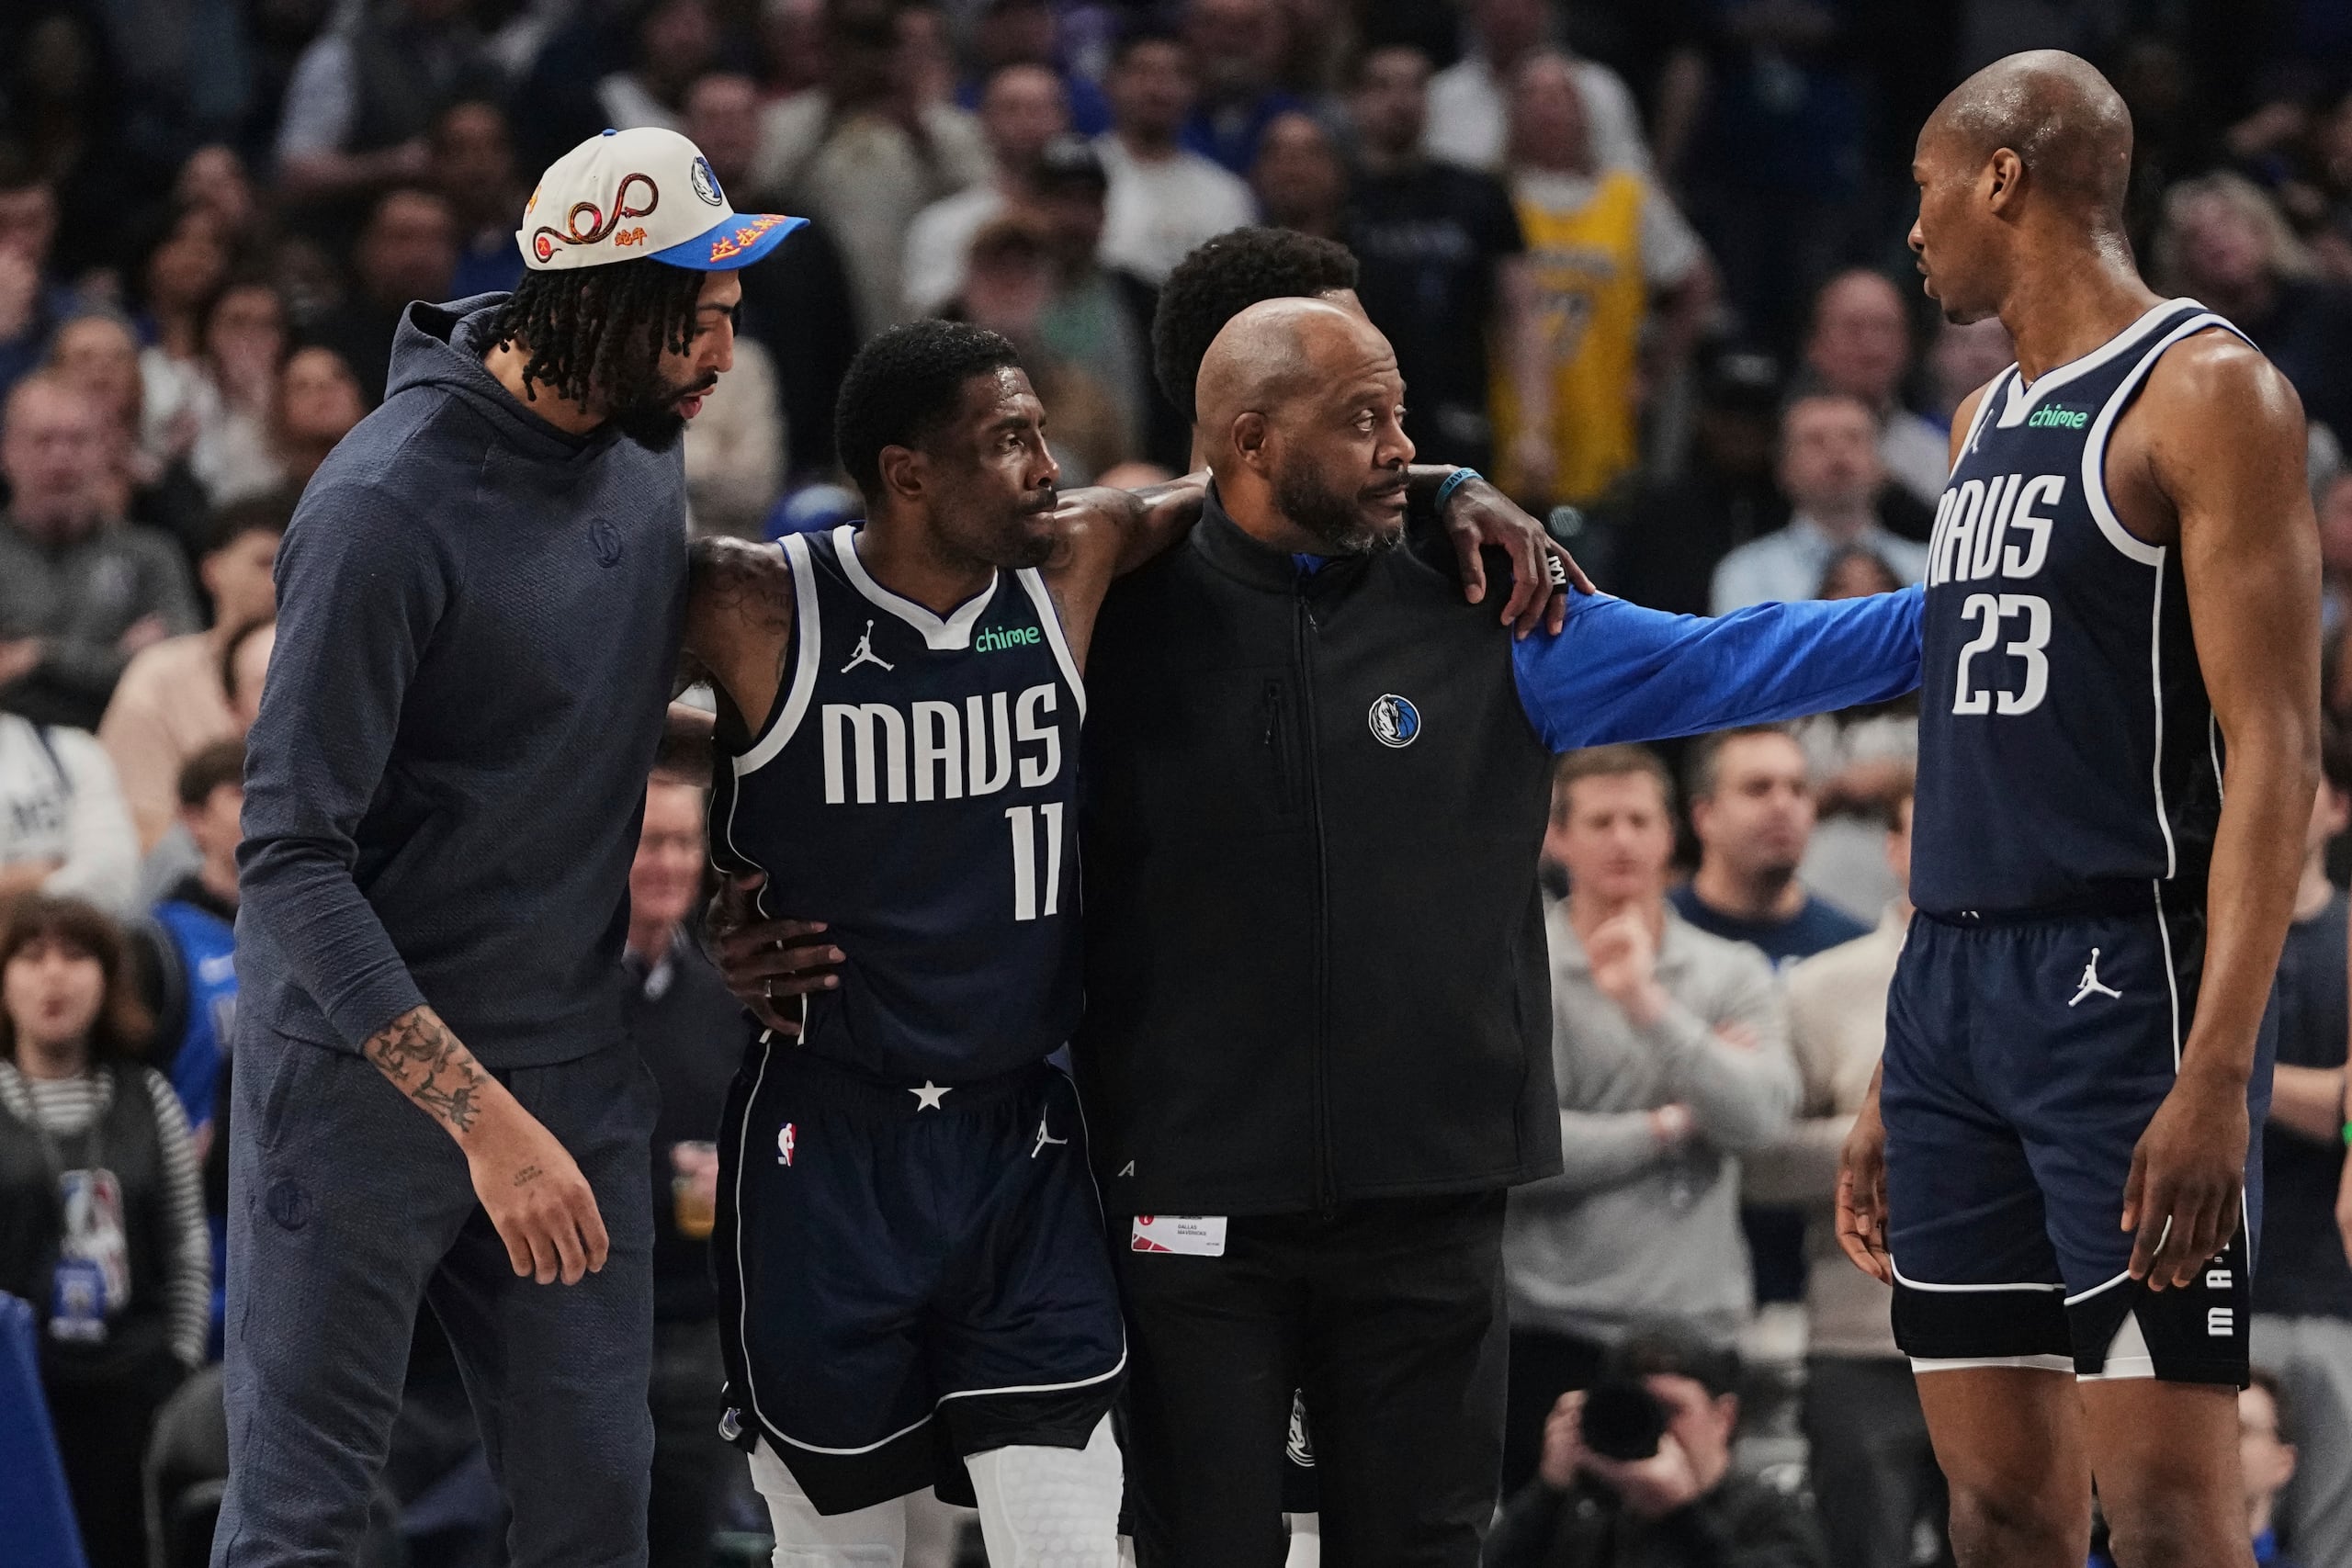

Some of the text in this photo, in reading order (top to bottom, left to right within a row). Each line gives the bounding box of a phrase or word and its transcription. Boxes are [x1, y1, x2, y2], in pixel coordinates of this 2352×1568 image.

[2029, 404, 2088, 428] chime
[1924, 473, 2066, 592] MAVS
[976, 626, 1041, 652] chime
[1952, 593, 2052, 715] 23
[822, 682, 1061, 804] MAVS
[1005, 802, 1063, 920] 11
